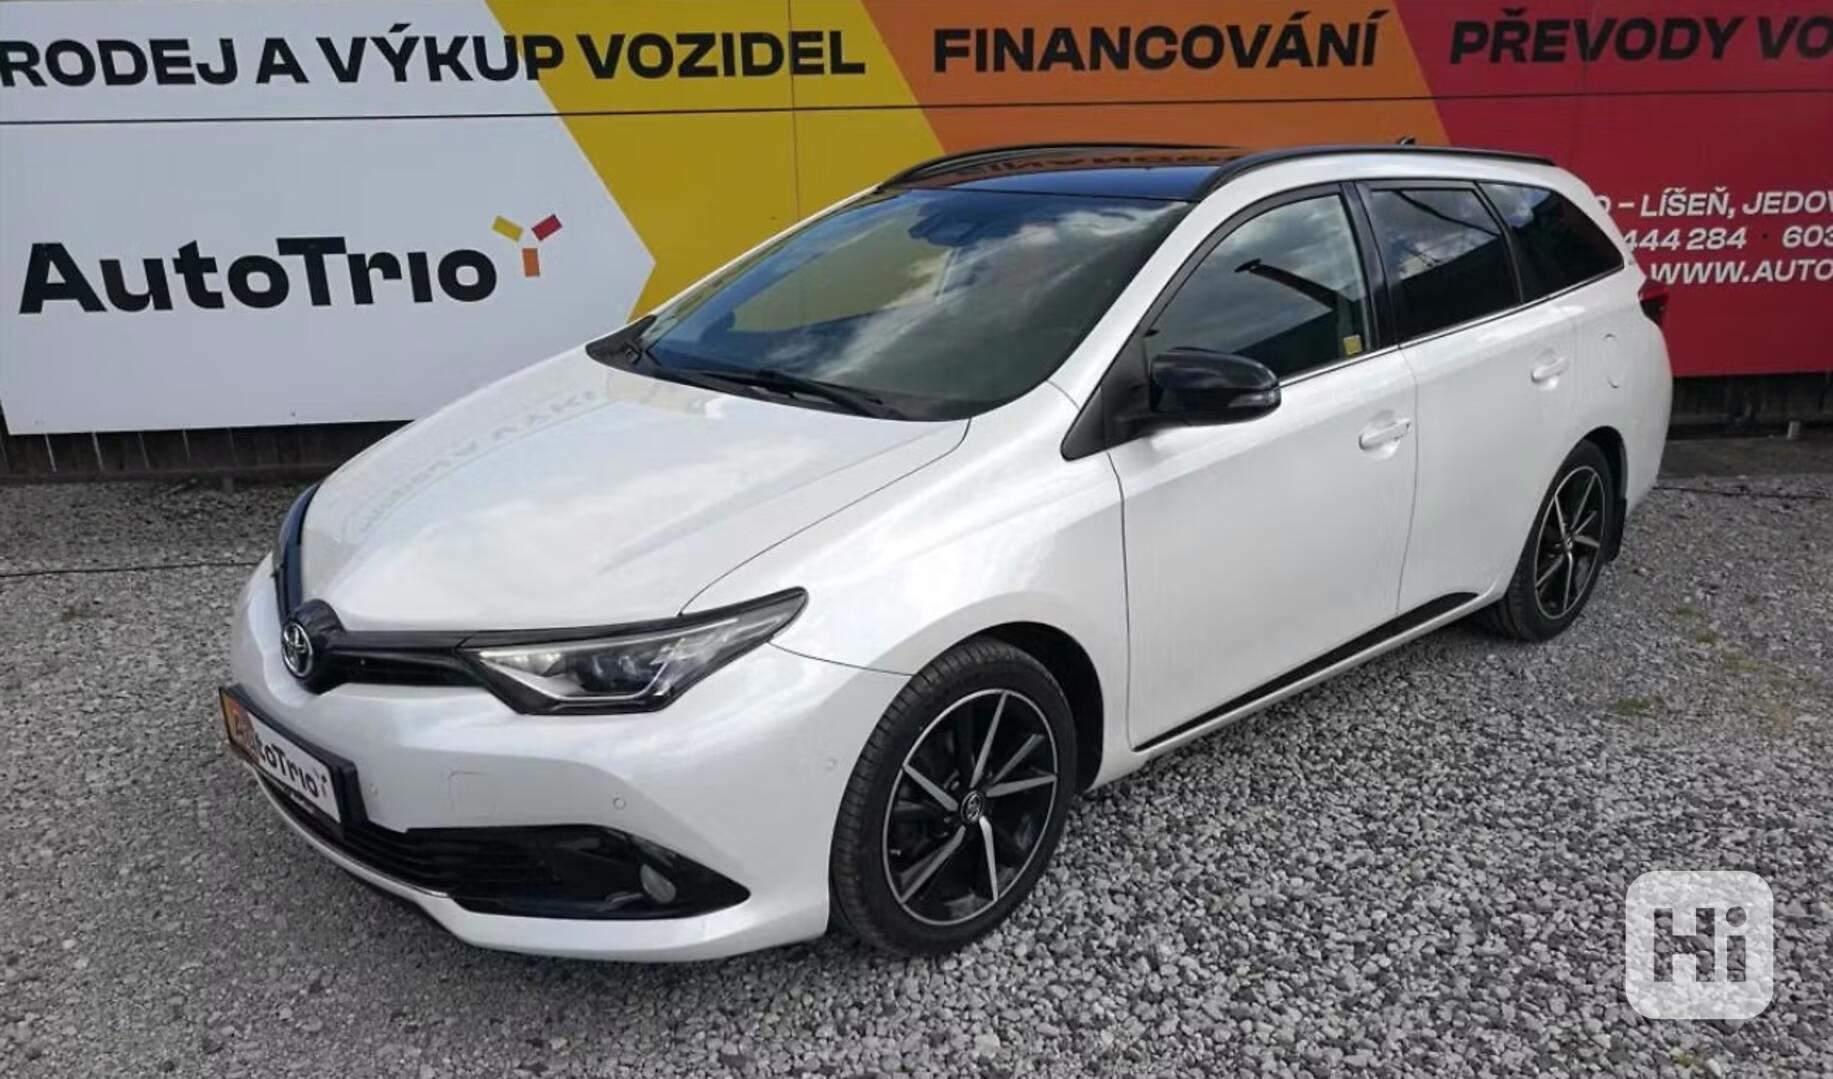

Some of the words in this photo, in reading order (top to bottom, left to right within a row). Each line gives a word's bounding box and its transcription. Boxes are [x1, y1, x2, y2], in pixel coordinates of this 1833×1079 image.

[0, 37, 238, 87] RODEJ
[256, 38, 310, 85] A
[316, 22, 565, 82] VÝKUP
[576, 30, 866, 80] VOZIDEL
[933, 9, 1391, 72] FINANCOVÁNÍ
[1449, 8, 1745, 65] PŘEVODY
[1757, 15, 1833, 60] VO
[1640, 186, 1735, 219] LÍŠEŇ,
[1742, 190, 1833, 215] JEDO
[1686, 226, 1747, 250] 284
[18, 236, 498, 315] AutoTrio
